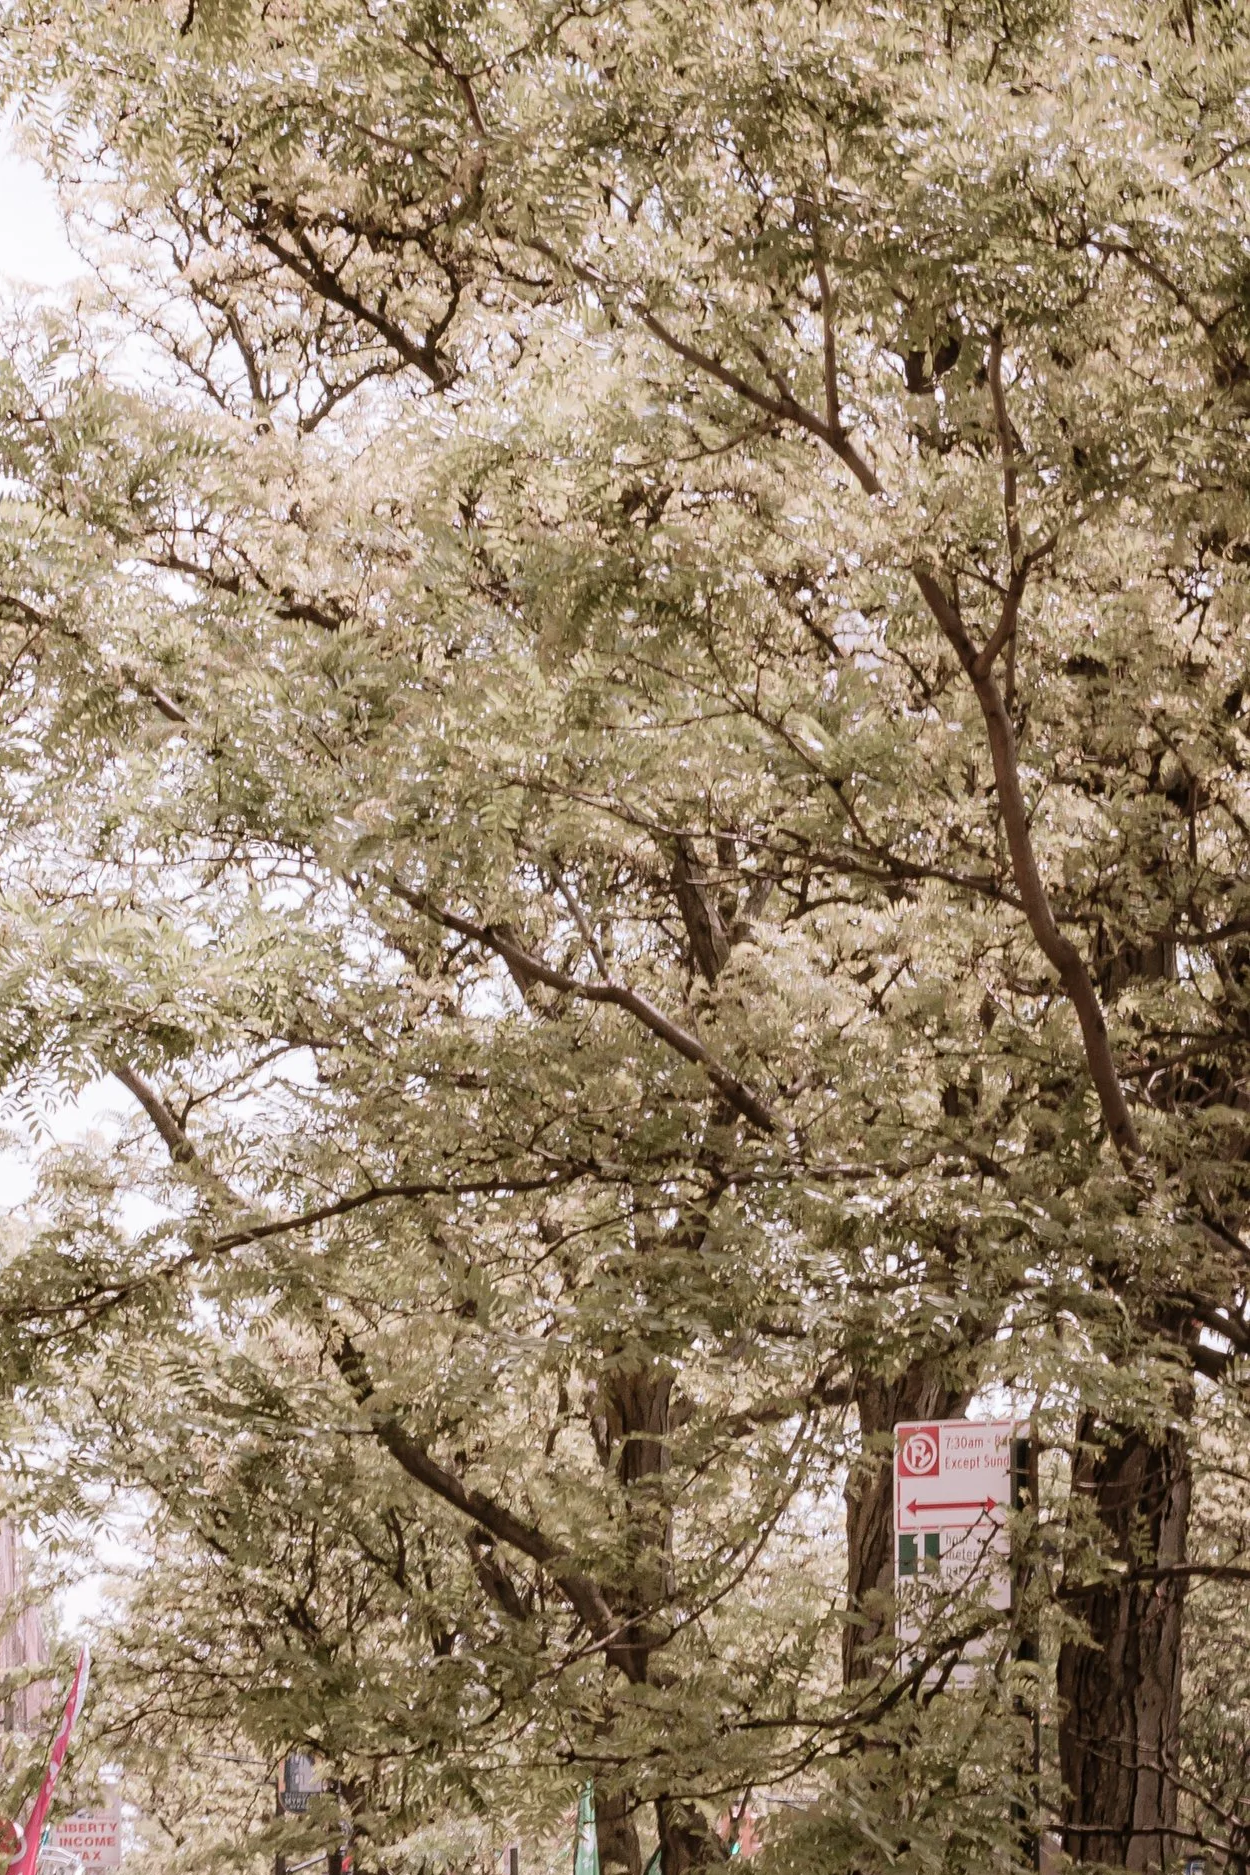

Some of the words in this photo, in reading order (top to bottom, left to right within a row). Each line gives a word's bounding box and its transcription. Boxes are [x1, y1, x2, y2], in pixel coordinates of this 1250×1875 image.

[945, 1436, 984, 1450] 7:30am
[944, 1455, 980, 1472] Except
[983, 1453, 1010, 1469] Sund
[56, 1822, 118, 1833] LIBERTY
[58, 1836, 117, 1847] INCOME
